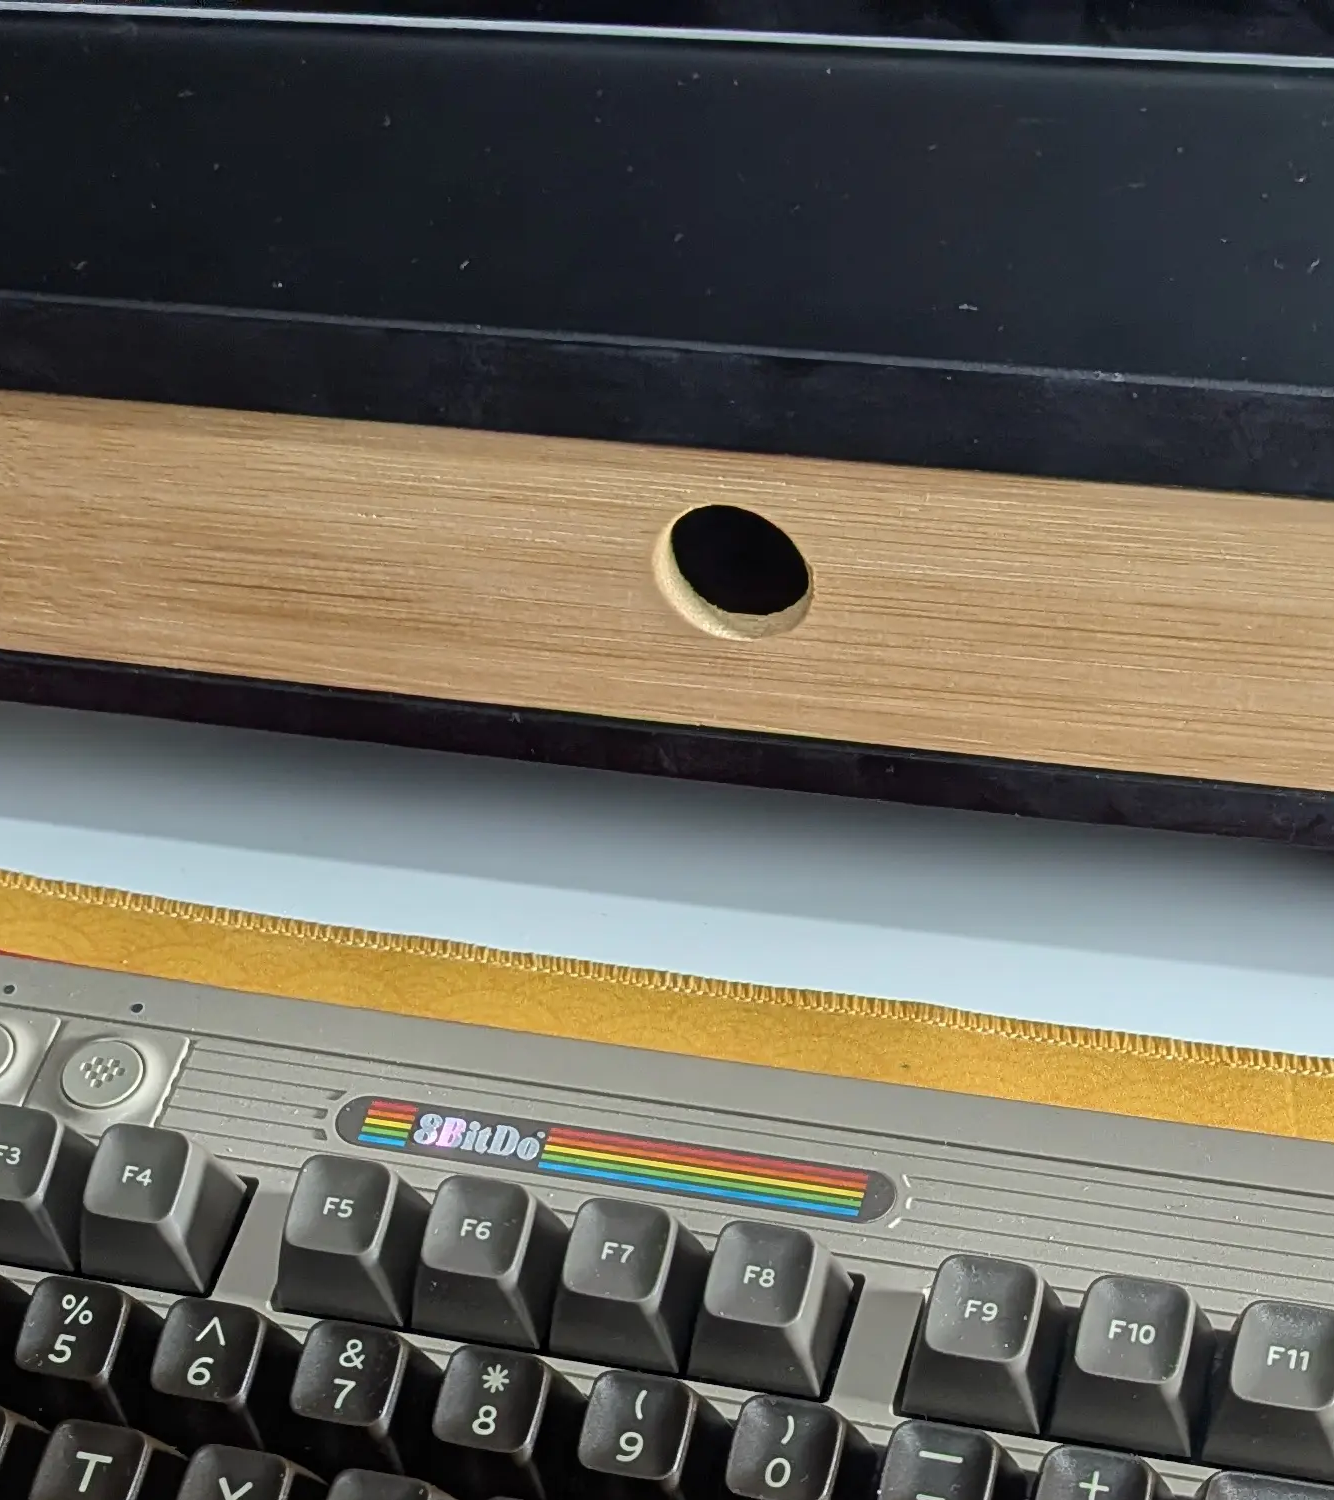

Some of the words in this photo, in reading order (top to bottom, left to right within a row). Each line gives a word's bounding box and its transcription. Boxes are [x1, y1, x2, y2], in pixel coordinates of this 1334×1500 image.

[413, 1113, 541, 1161] 8BitDo
[121, 1165, 152, 1187] F4
[322, 1196, 354, 1218] F5
[460, 1218, 492, 1240] F6
[601, 1241, 635, 1264] F7
[743, 1265, 775, 1288] F8
[61, 1294, 93, 1325] %
[964, 1299, 998, 1322] F9
[1108, 1319, 1156, 1345] F10
[47, 1333, 77, 1364] 5
[338, 1338, 366, 1370] &
[1266, 1345, 1310, 1371] F11
[187, 1356, 214, 1386] 6
[333, 1378, 357, 1409] 7
[635, 1389, 648, 1420] (
[471, 1405, 498, 1436] 8
[780, 1415, 795, 1445] )
[615, 1431, 644, 1462] 9
[75, 1450, 113, 1493] T
[764, 1457, 791, 1488] 0
